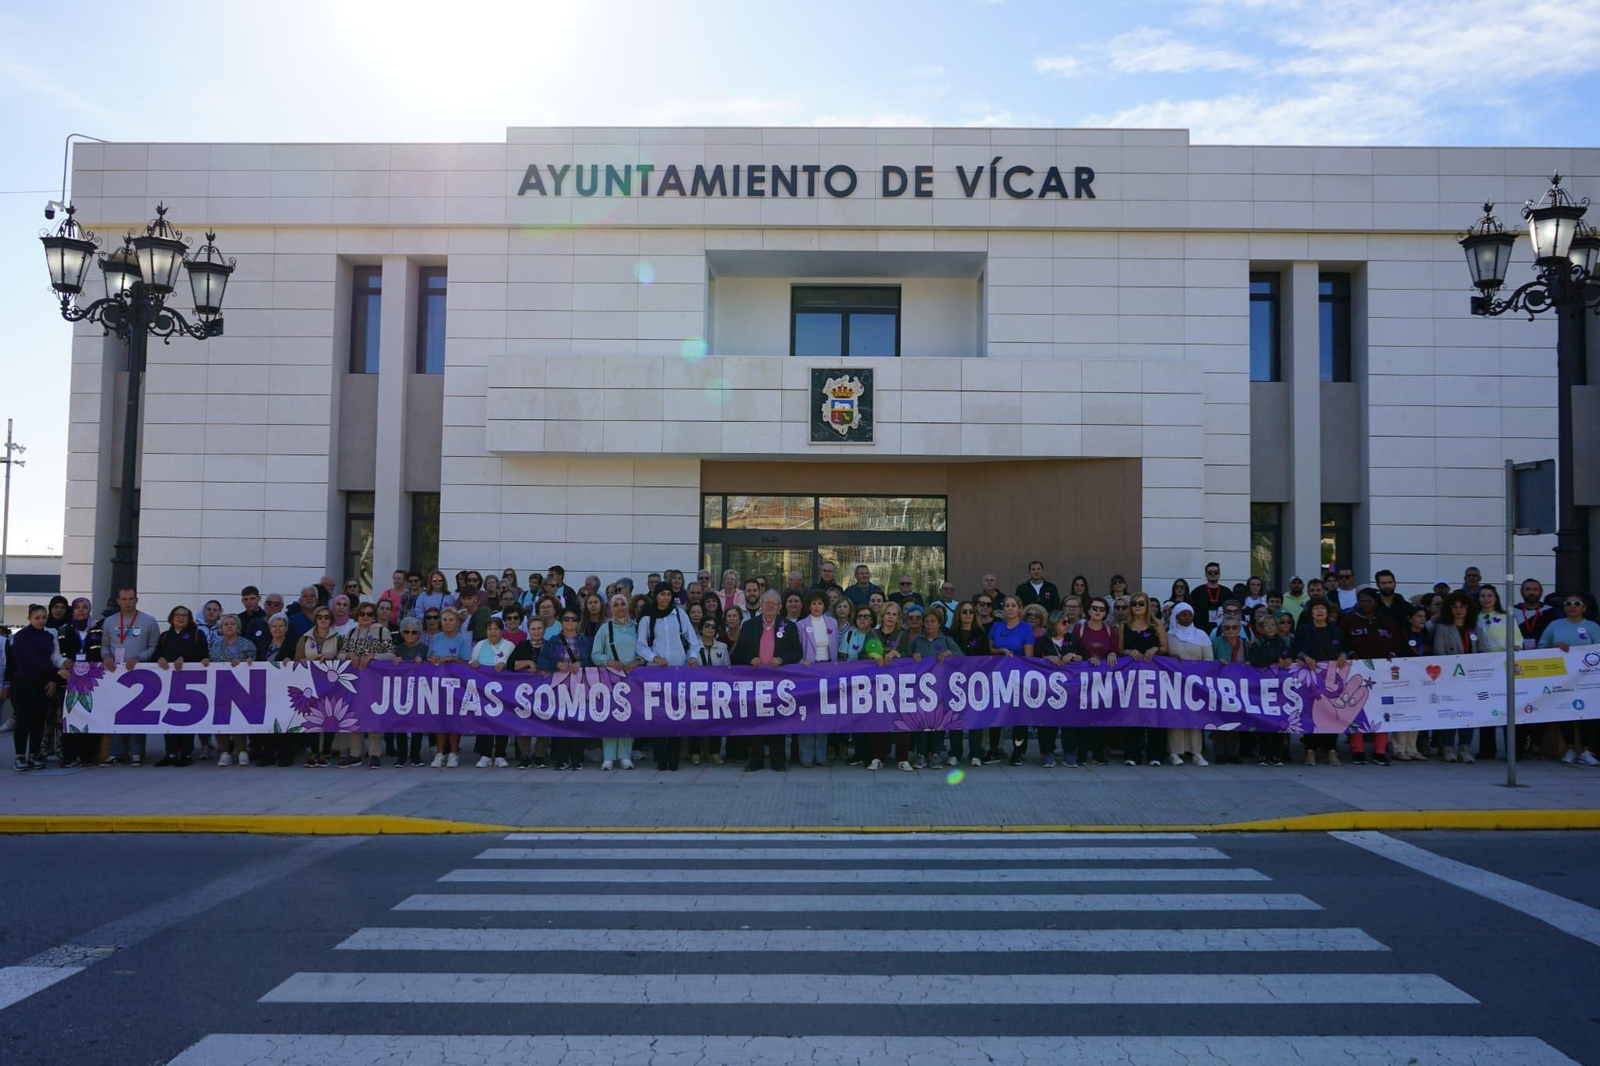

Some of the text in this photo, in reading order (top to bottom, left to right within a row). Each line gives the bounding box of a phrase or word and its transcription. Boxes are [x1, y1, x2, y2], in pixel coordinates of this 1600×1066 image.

[517, 155, 1097, 201] AYUNTAMIENTO DE VÍCAR
[113, 668, 268, 726] 25N
[370, 669, 1303, 722] JUNTAS SOMOS FUERTES, LIBRES SOMOS INVENCIBLES
